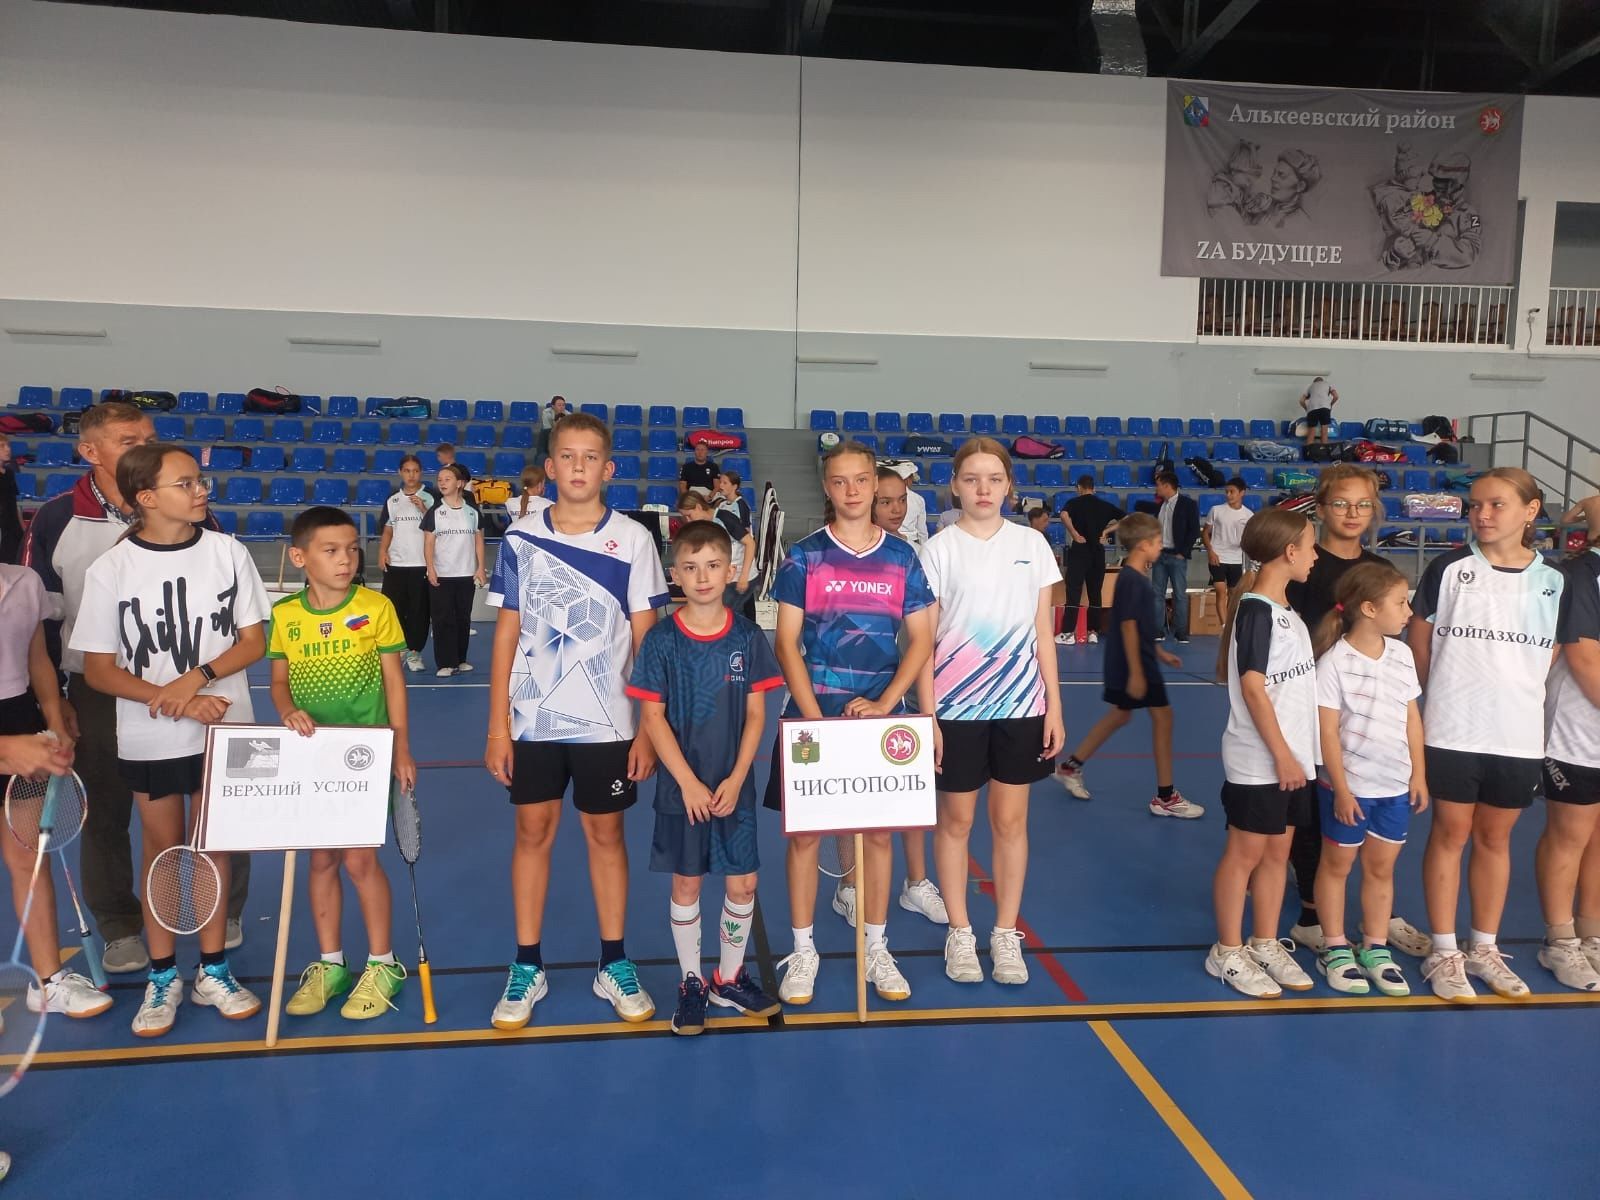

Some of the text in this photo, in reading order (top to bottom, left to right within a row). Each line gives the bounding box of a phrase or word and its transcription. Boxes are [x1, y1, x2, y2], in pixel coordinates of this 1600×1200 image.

[1228, 103, 1456, 134] Алькеевский район
[1196, 241, 1342, 267] ZA БУДУЩЕЕ
[850, 580, 893, 596] YONEX
[288, 627, 301, 641] 49
[793, 774, 927, 797] ЧИСТОПОЛЬ
[1544, 757, 1570, 791] ONEX
[222, 780, 369, 798] ВЕРХНИЙ УСЛОН
